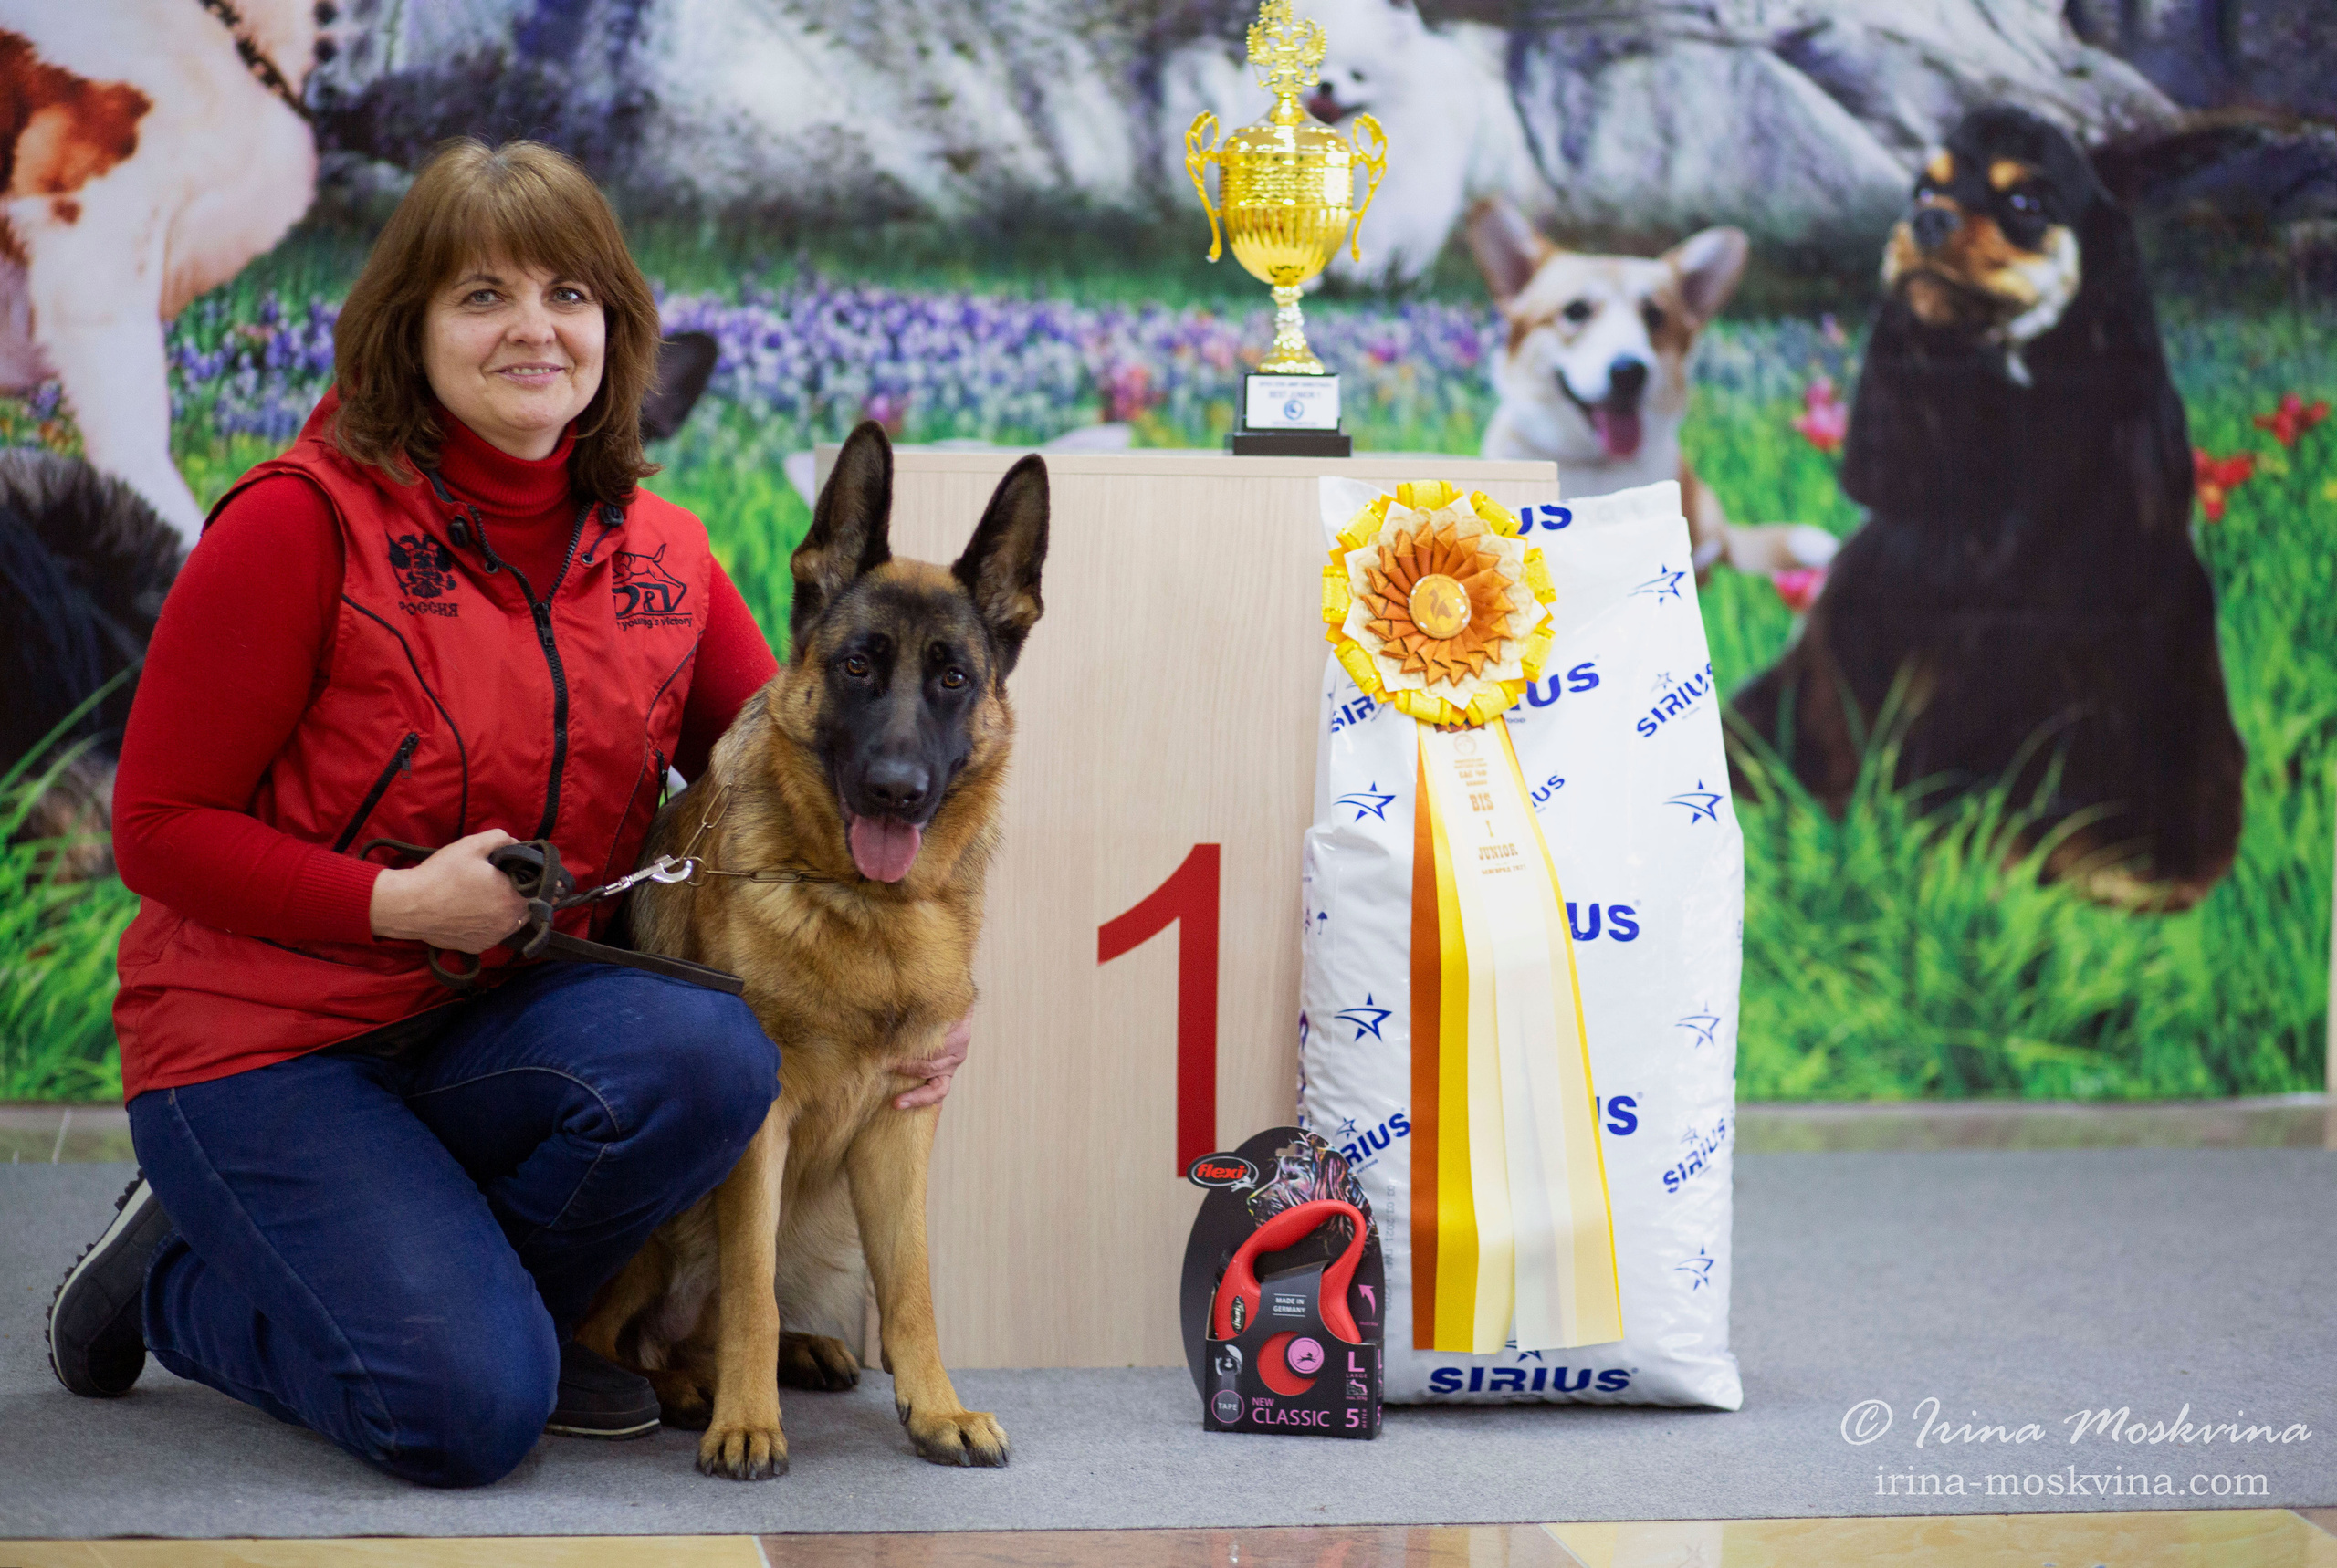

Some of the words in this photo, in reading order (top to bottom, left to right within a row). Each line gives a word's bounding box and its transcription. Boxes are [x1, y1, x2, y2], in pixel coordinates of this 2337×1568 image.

[660, 616, 693, 627] victory
[1469, 792, 1493, 812] BIS
[1478, 843, 1519, 861] JUNIOR
[1098, 843, 1221, 1178] 1
[1340, 1113, 1410, 1167] RIUS
[1196, 1163, 1245, 1179] flexi
[1273, 1305, 1305, 1313] GERMANY
[1275, 1297, 1295, 1305] MADE
[1348, 1351, 1366, 1373] L
[1428, 1366, 1631, 1394] SIRIUS
[1218, 1402, 1238, 1411] TAPE
[1252, 1397, 1275, 1406] NEW
[1252, 1408, 1330, 1427] CLASSIC
[1345, 1408, 1360, 1428] 5
